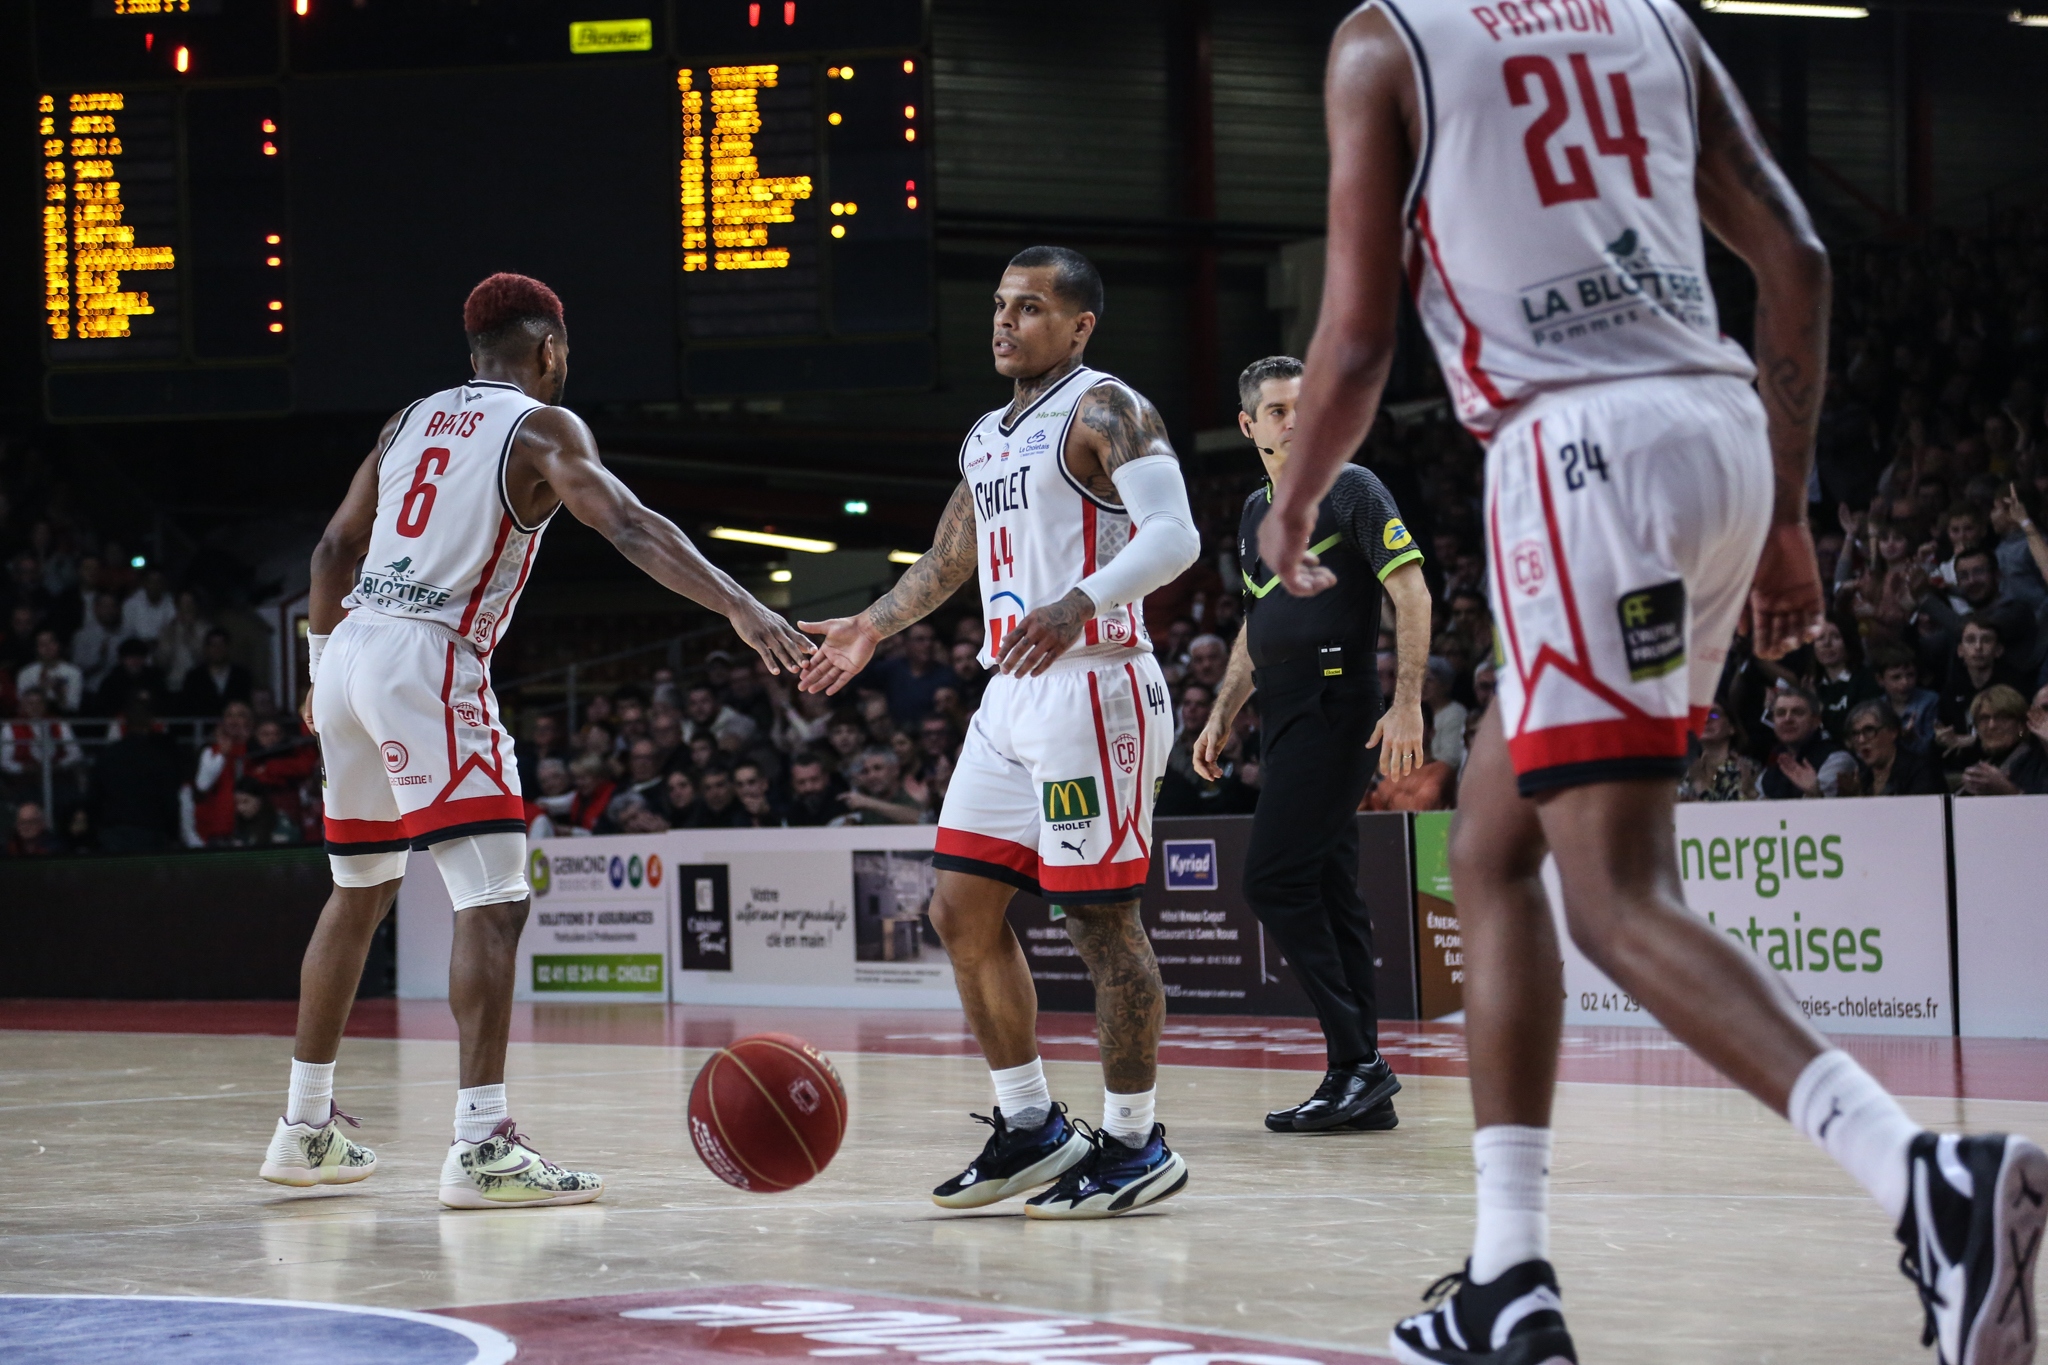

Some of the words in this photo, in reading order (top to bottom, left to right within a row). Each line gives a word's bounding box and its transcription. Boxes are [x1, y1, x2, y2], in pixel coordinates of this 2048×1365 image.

[1502, 53, 1653, 208] 24
[1521, 288, 1571, 324] LA
[1559, 438, 1611, 492] 24
[396, 447, 451, 539] 6
[975, 465, 1031, 523] CHOLET
[989, 526, 1014, 582] 44
[1146, 682, 1165, 716] 44
[1116, 741, 1136, 766] CB
[1052, 820, 1092, 832] CHOLET
[1169, 852, 1211, 877] Kyriad
[1680, 820, 1844, 898] nergies
[784, 934, 796, 948] en
[799, 931, 824, 948] main
[617, 964, 658, 983] CHOLET
[1580, 992, 1599, 1011] 02
[1602, 993, 1619, 1011] 41
[1799, 995, 1938, 1019] gies-choletaises.fr
